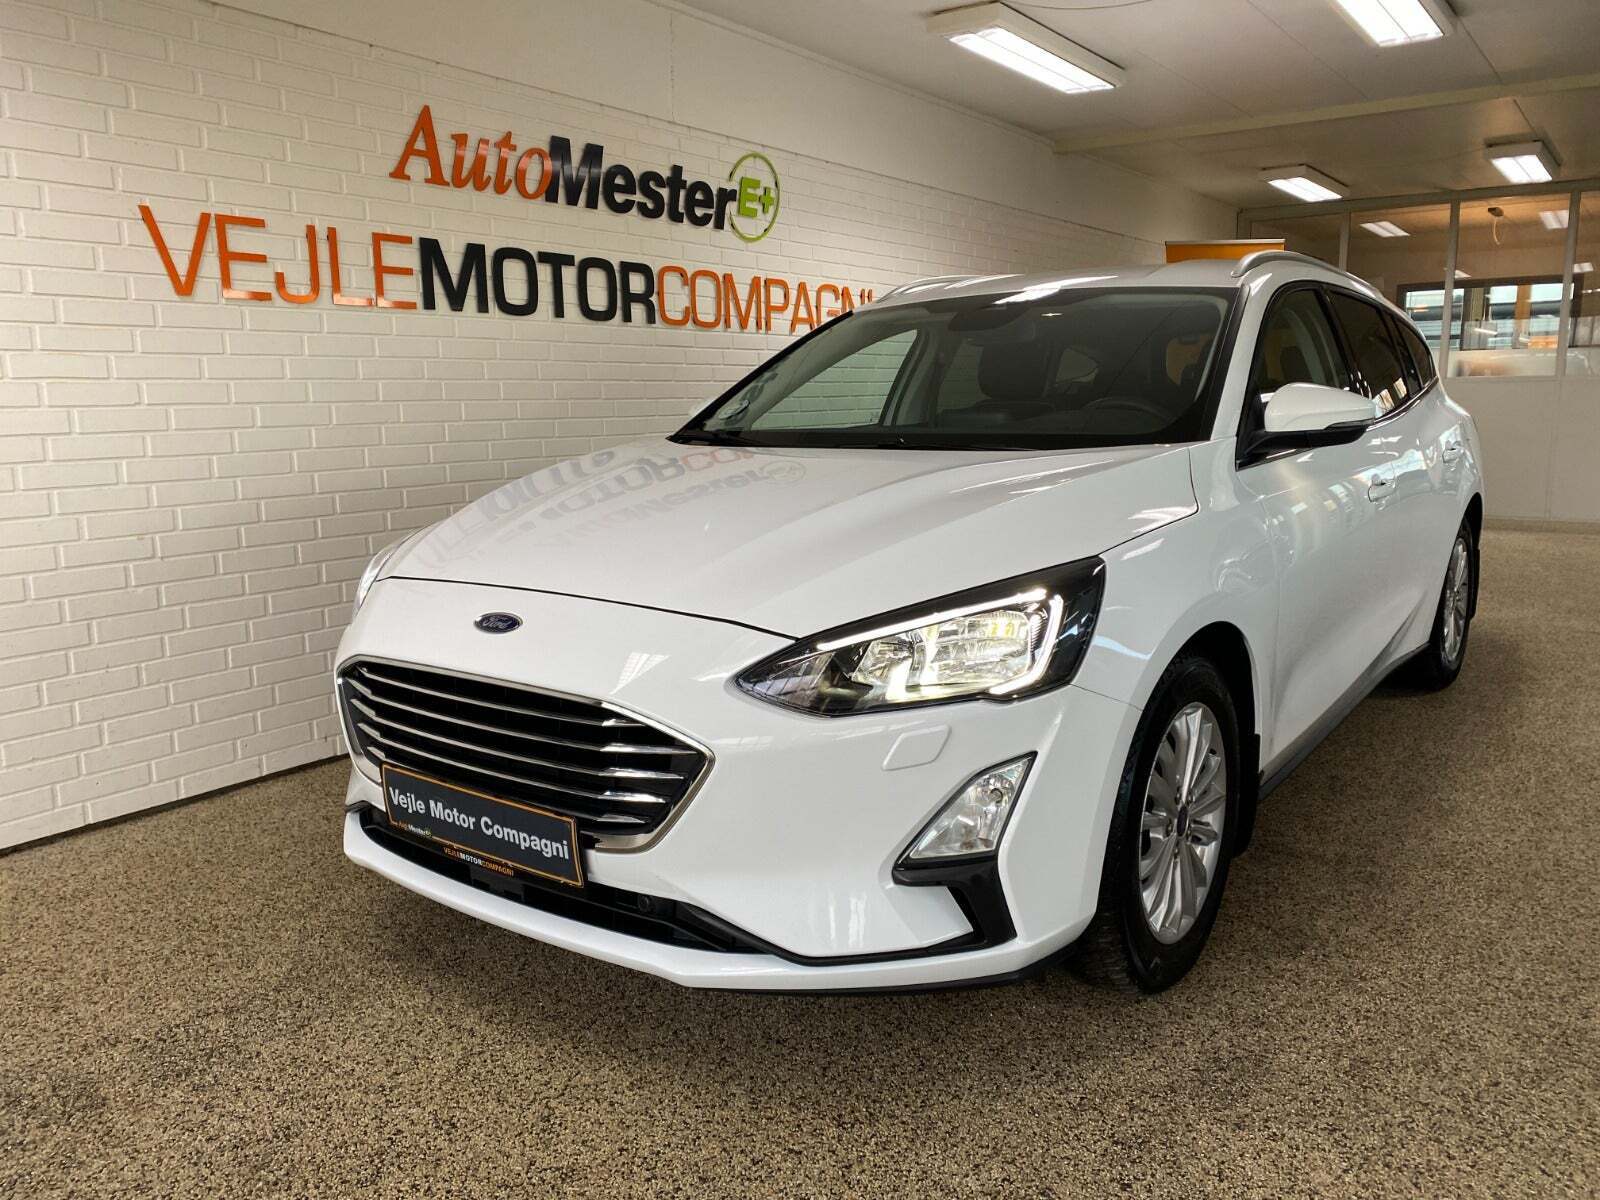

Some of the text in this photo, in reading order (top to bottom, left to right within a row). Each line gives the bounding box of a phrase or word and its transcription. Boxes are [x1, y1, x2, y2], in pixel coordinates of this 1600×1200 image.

[389, 105, 738, 230] AutoMester
[388, 786, 570, 860] Vejle Motor Compagni
